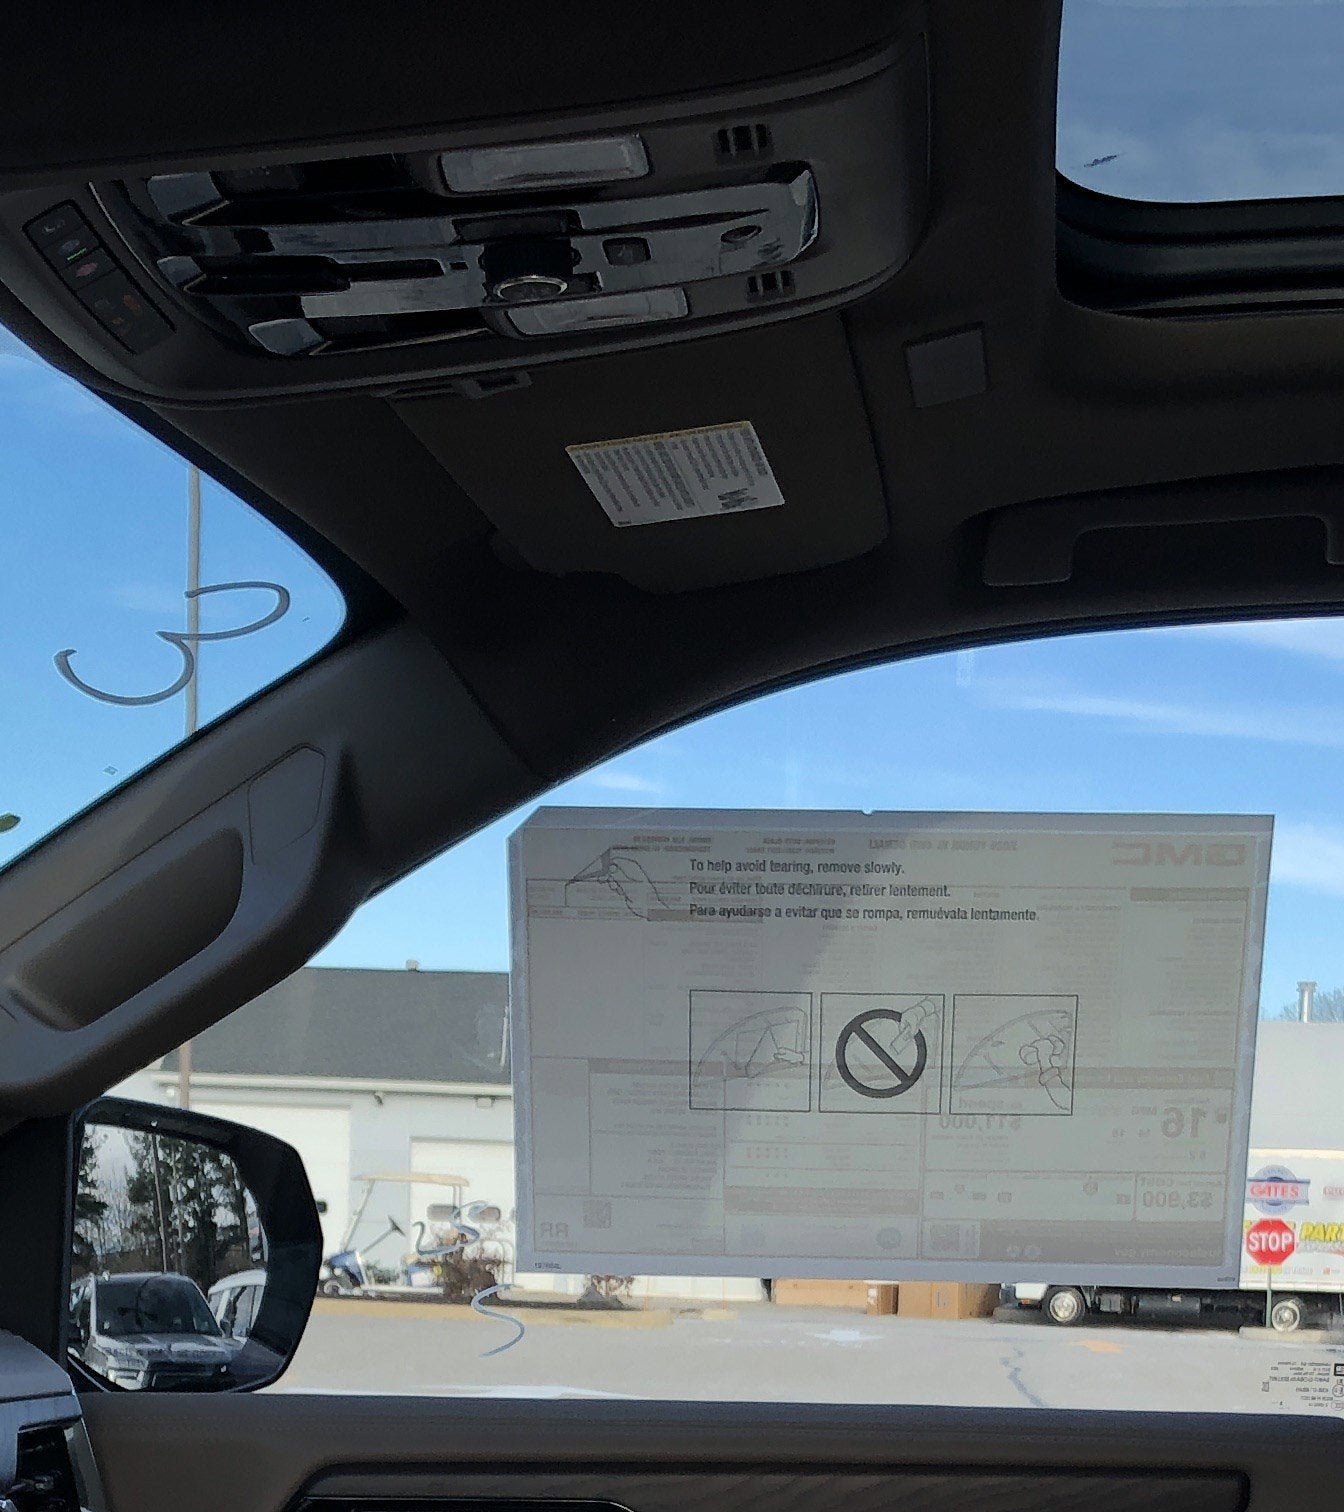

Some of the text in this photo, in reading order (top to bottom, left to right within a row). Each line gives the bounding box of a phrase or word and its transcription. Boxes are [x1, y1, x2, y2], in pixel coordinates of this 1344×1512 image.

[689, 858, 905, 876] To help avoid tearing, remove slowly.
[689, 881, 951, 899] Pour éviter toute déchirure, retirer lentement.
[689, 903, 1040, 923] Para ayudarse a evitar que se rompa, remuévala lentamente.
[1248, 1231, 1294, 1253] STOP
